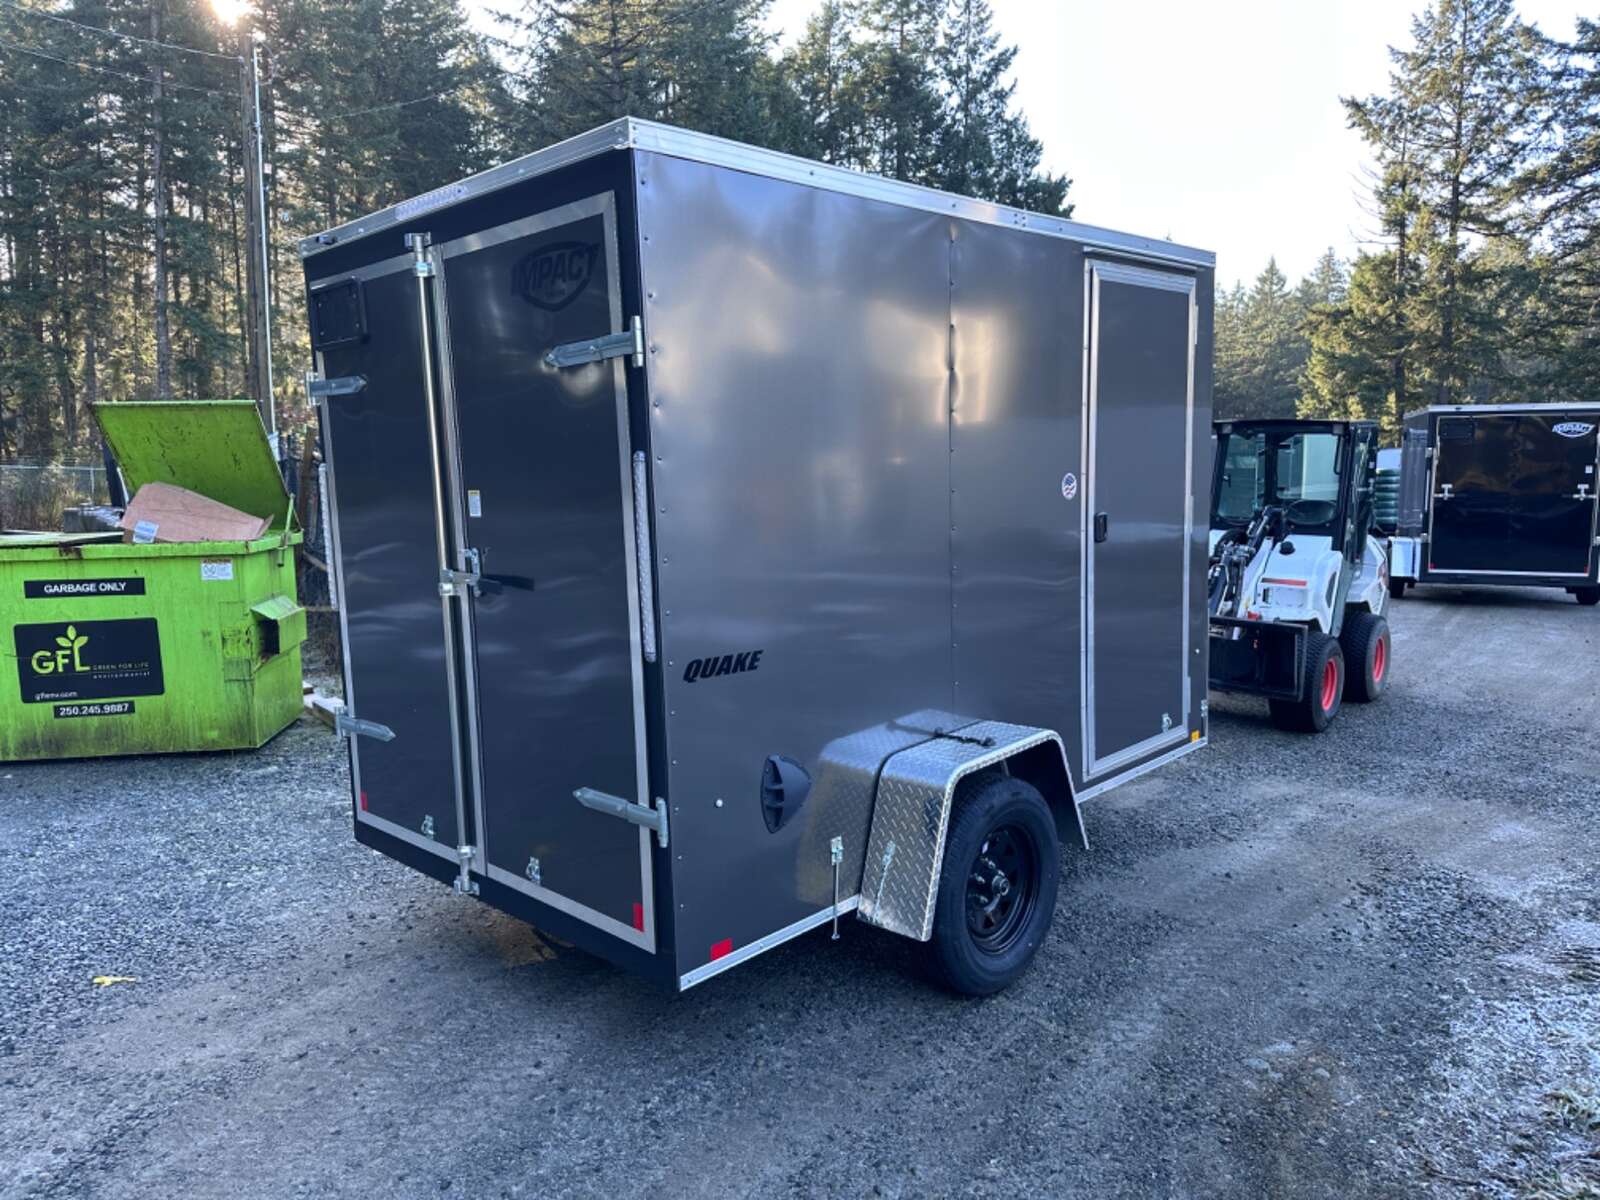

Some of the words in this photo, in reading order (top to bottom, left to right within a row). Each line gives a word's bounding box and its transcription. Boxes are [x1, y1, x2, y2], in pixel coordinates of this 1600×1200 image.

[511, 243, 601, 295] IMPACT
[44, 583, 96, 593] GARBAGE
[98, 582, 126, 591] ONLY
[31, 638, 90, 674] GFL
[683, 650, 764, 683] QUAKE
[59, 703, 129, 716] 250.245.9887
